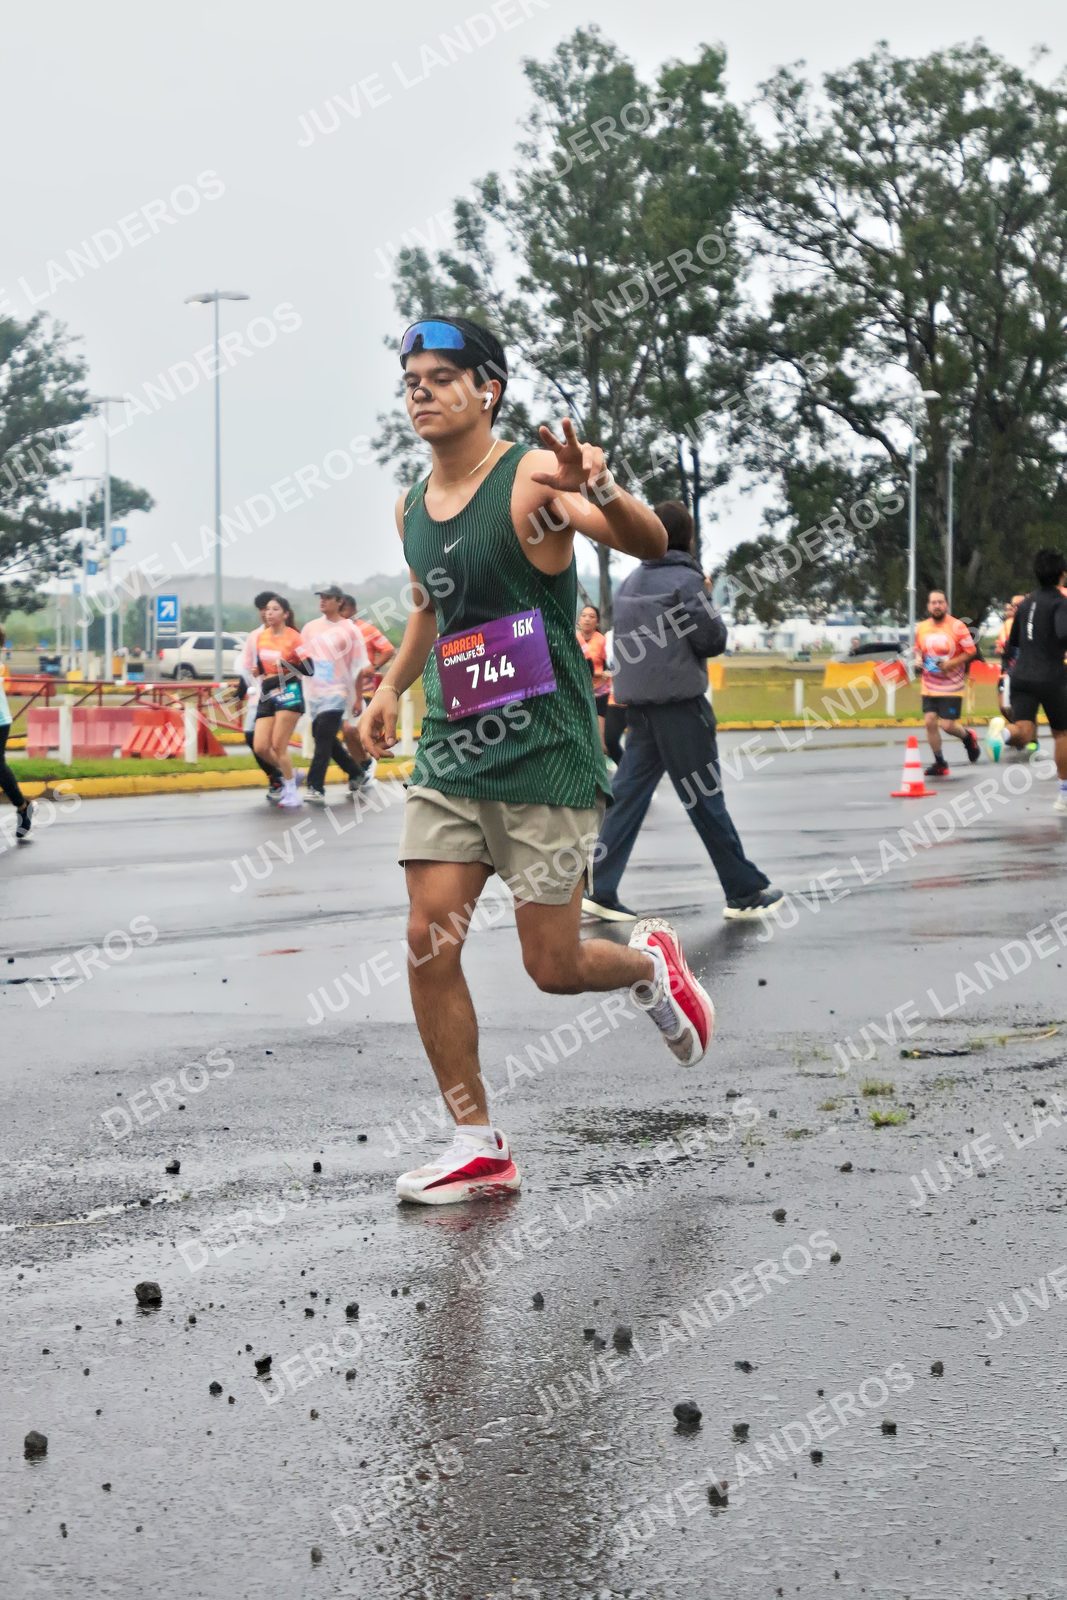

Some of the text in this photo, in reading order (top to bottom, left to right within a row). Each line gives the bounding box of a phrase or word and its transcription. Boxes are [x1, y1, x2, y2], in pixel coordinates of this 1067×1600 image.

[512, 617, 534, 638] 16K
[442, 632, 485, 658] CARRERA
[443, 650, 477, 667] OMNILIFE
[466, 655, 515, 688] 744
